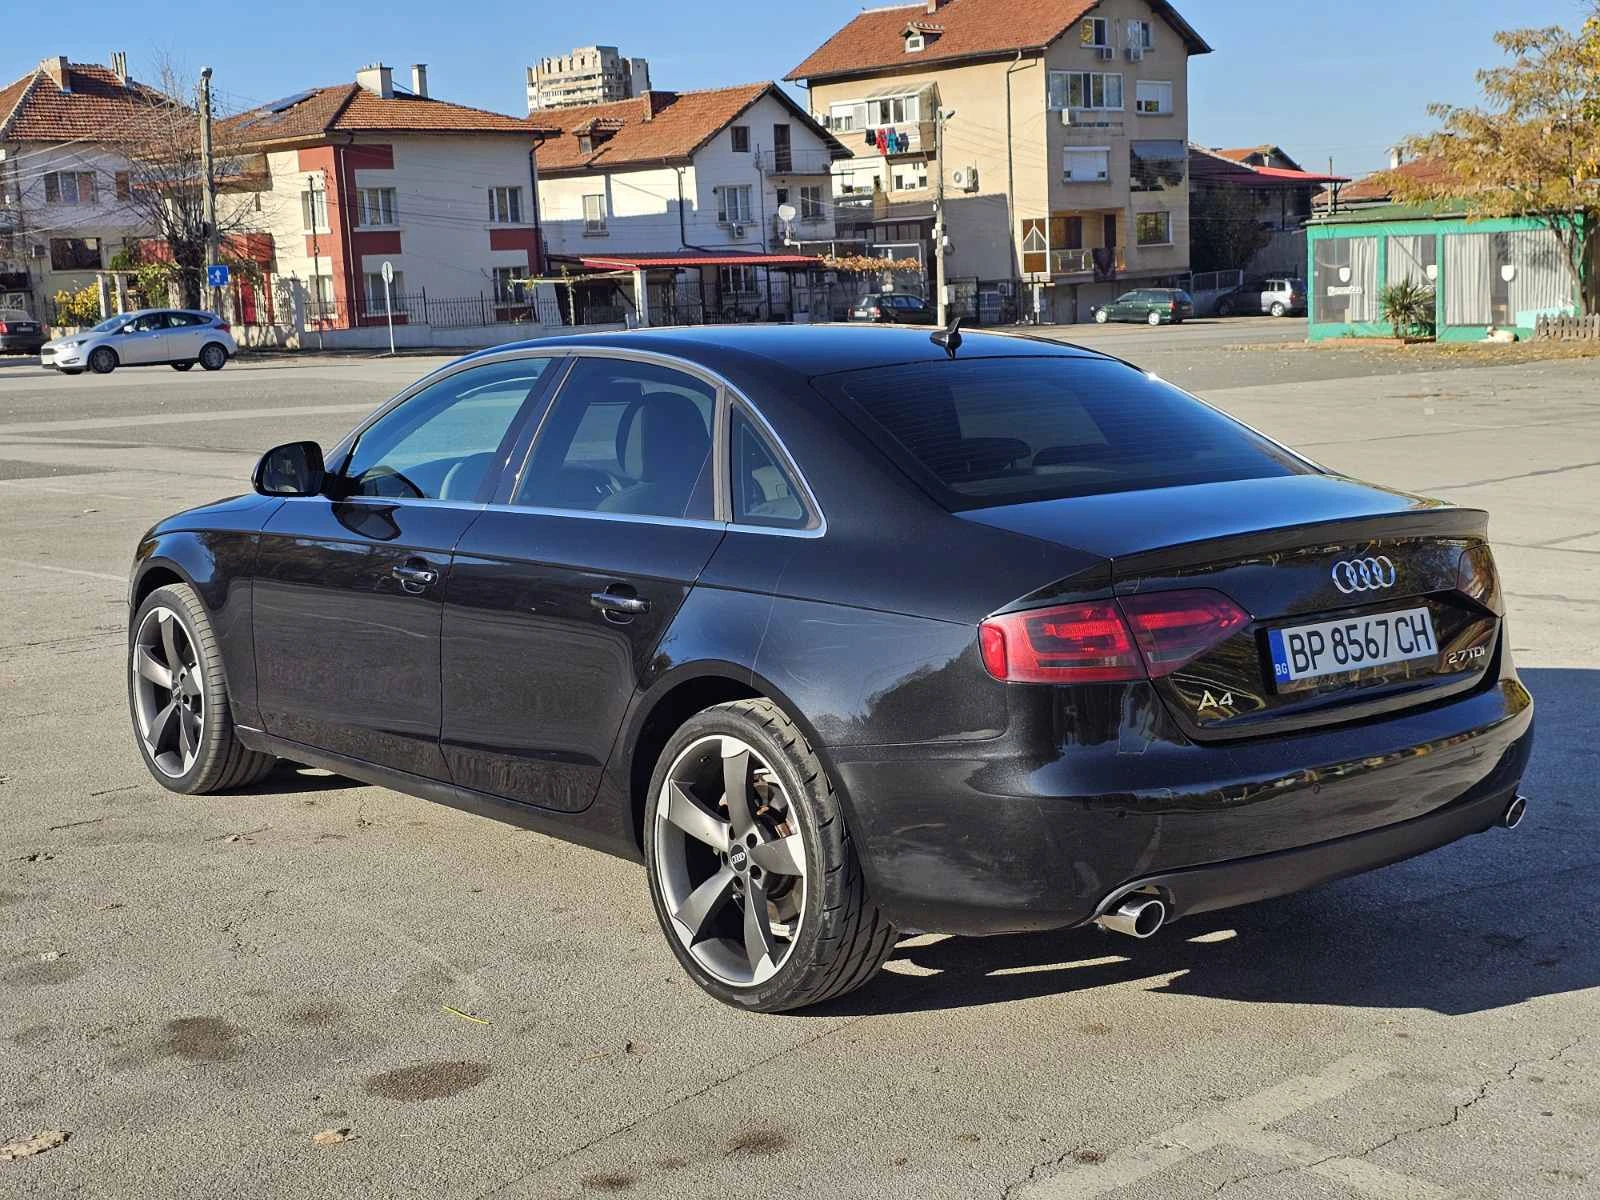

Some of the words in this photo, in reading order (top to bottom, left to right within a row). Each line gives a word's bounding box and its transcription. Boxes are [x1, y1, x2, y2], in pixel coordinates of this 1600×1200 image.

[1289, 630, 1325, 673] BP
[1331, 619, 1389, 665] 8567
[1395, 614, 1431, 653] CH
[1275, 662, 1288, 676] BG
[1198, 690, 1234, 711] A4
